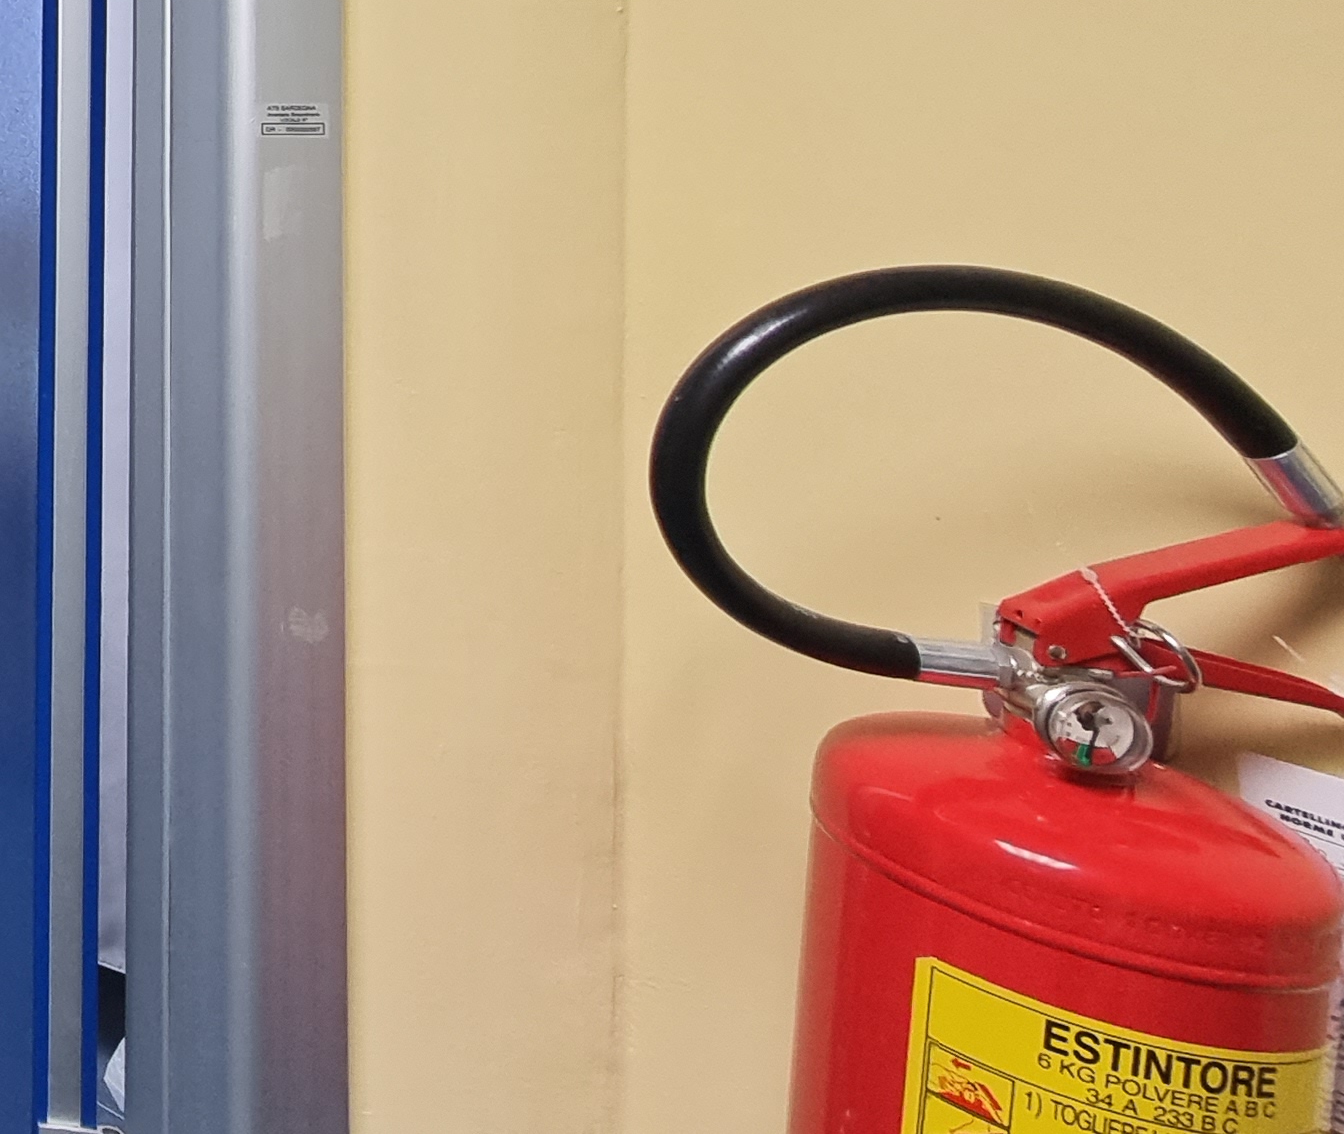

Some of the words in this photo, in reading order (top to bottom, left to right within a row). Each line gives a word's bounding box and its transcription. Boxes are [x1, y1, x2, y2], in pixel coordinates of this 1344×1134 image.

[1265, 799, 1344, 831] CARTELLIN
[1043, 1018, 1278, 1099] ESTINTORE
[1024, 1090, 1043, 1120] 1)
[1037, 1053, 1052, 1070] 6
[1059, 1059, 1096, 1085] KG
[1104, 1073, 1219, 1115] POLVERE
[1225, 1099, 1240, 1116] A
[1244, 1100, 1259, 1118] B
[1263, 1100, 1277, 1119] C
[1085, 1087, 1113, 1109] 34
[1121, 1098, 1138, 1116] A
[1153, 1105, 1194, 1129] 233
[1201, 1115, 1217, 1132] B
[1222, 1117, 1239, 1134] C
